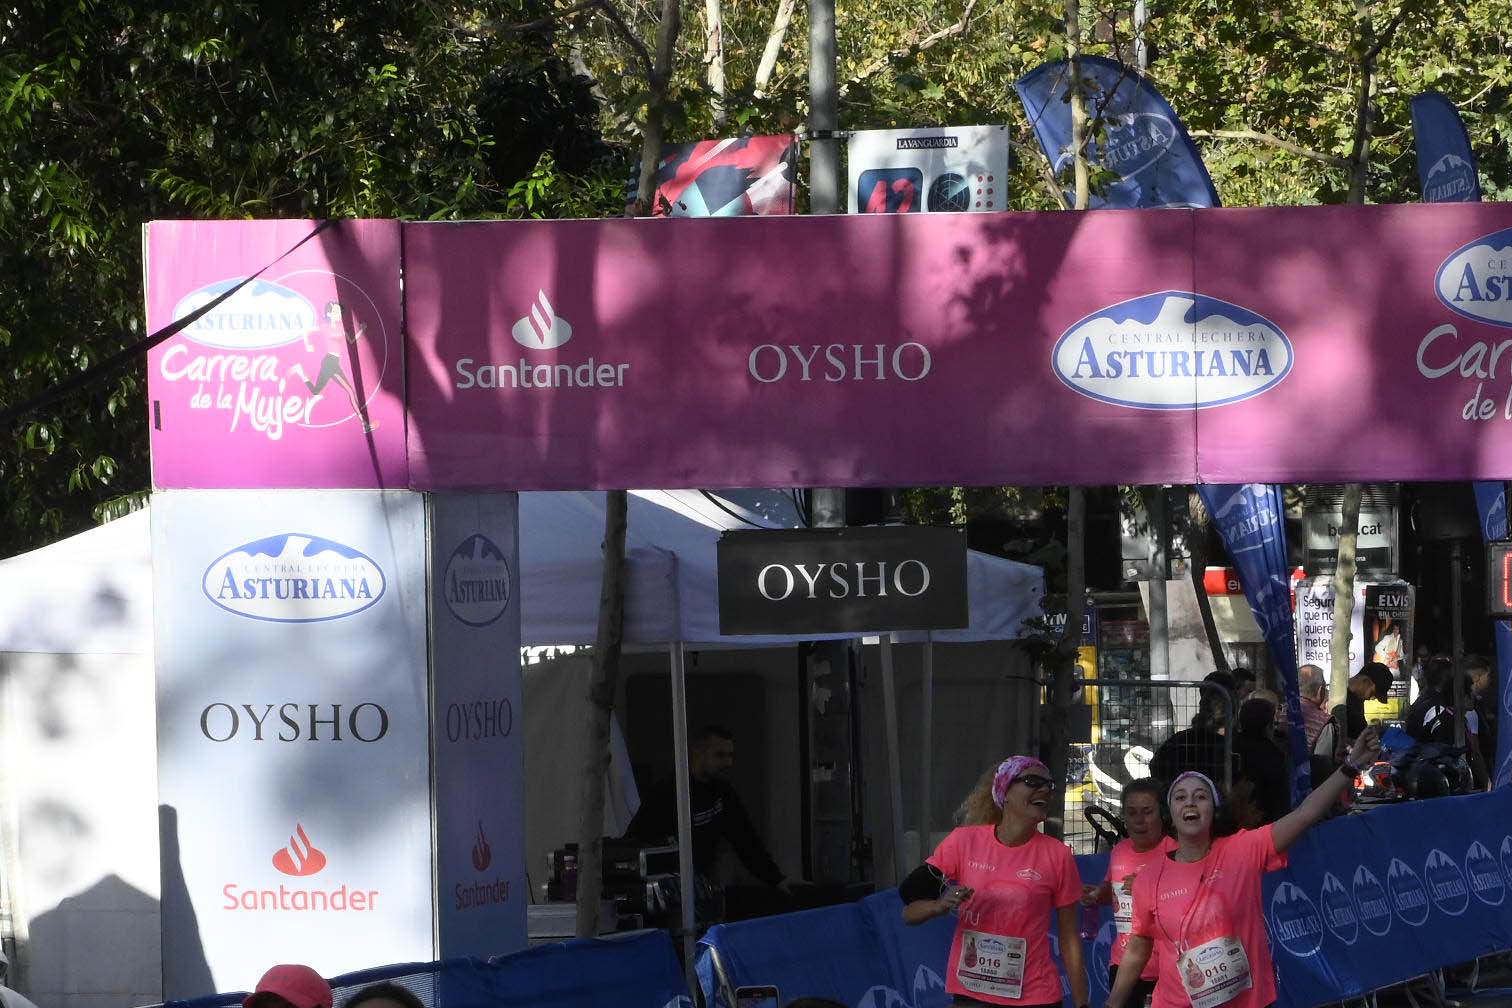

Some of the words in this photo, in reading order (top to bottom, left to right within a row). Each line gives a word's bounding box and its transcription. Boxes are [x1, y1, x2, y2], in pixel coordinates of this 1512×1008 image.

[1108, 332, 1184, 344] CENTRAL
[1191, 331, 1267, 344] LECHERA
[160, 343, 279, 382] Carrera
[456, 357, 630, 389] Santander
[747, 341, 933, 384] OYSHO
[1071, 336, 1275, 379] ASTURIANA
[190, 388, 211, 409] de
[216, 387, 233, 409] la
[230, 378, 323, 441] Mujer
[1462, 383, 1498, 421] de
[217, 566, 373, 601] ASTURIANA
[450, 575, 507, 604] ASTURIANA
[757, 559, 931, 601] OYSHO
[1303, 612, 1321, 626] que
[1305, 650, 1324, 661] este
[200, 702, 389, 743] OYSHO
[446, 697, 513, 743] OYSHO
[223, 884, 379, 911] Santander
[455, 878, 512, 911] Santander
[978, 956, 1001, 969] 016
[1205, 962, 1227, 978] 016
